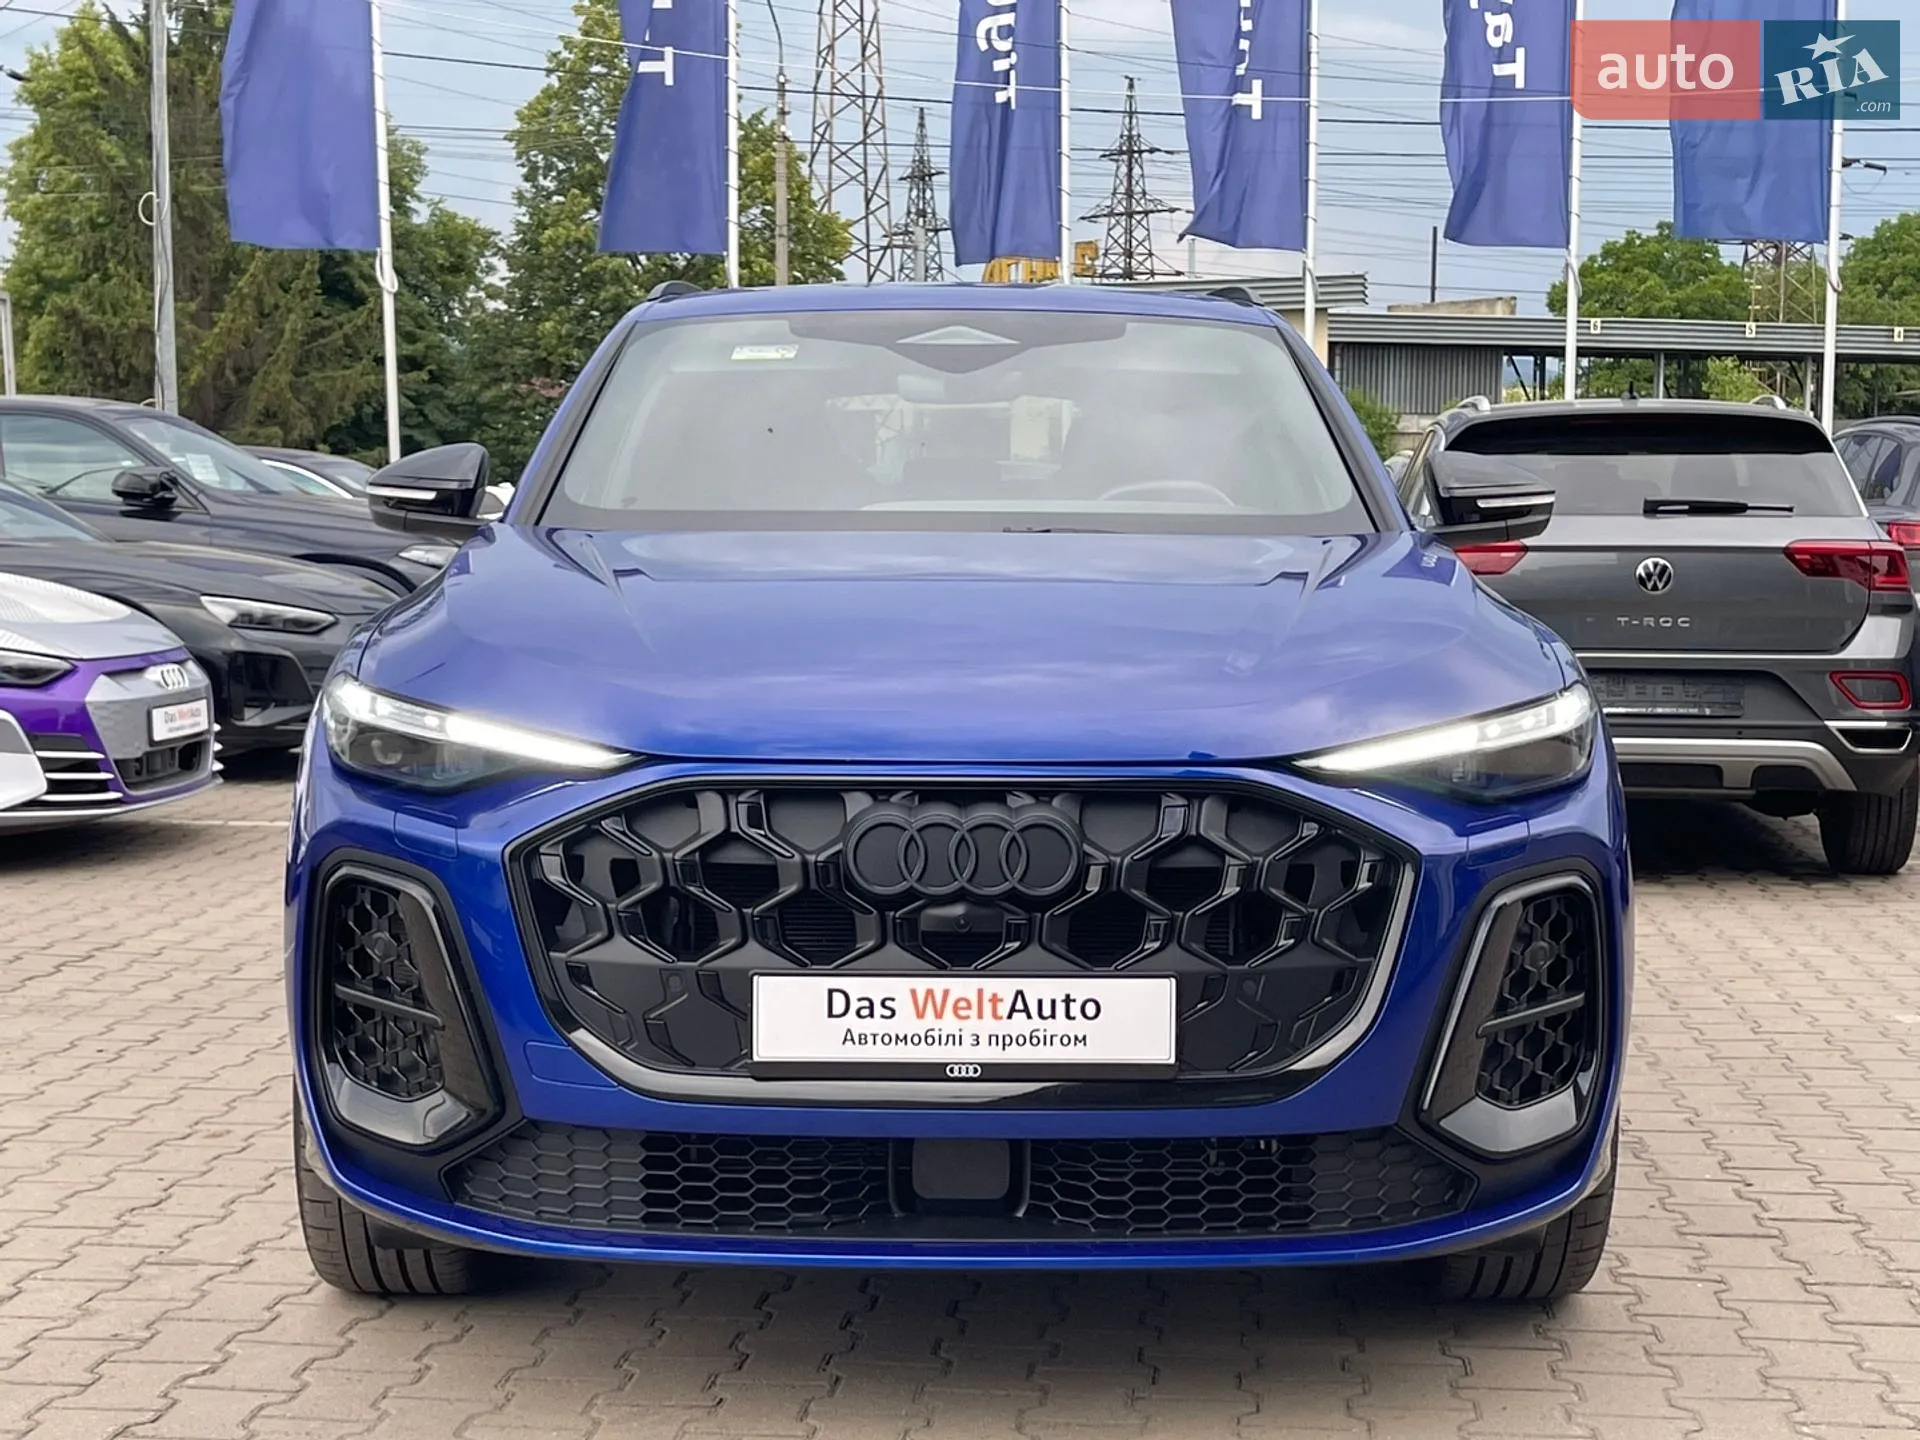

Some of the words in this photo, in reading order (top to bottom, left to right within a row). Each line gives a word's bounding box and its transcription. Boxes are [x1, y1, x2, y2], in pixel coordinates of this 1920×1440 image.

[1616, 616, 1692, 628] T-ROC
[826, 988, 896, 1020] Das
[909, 987, 1102, 1021] WeltAuto
[841, 1027, 964, 1047] Автомобілі
[969, 1032, 980, 1047] з
[987, 1027, 1088, 1052] пробігом
